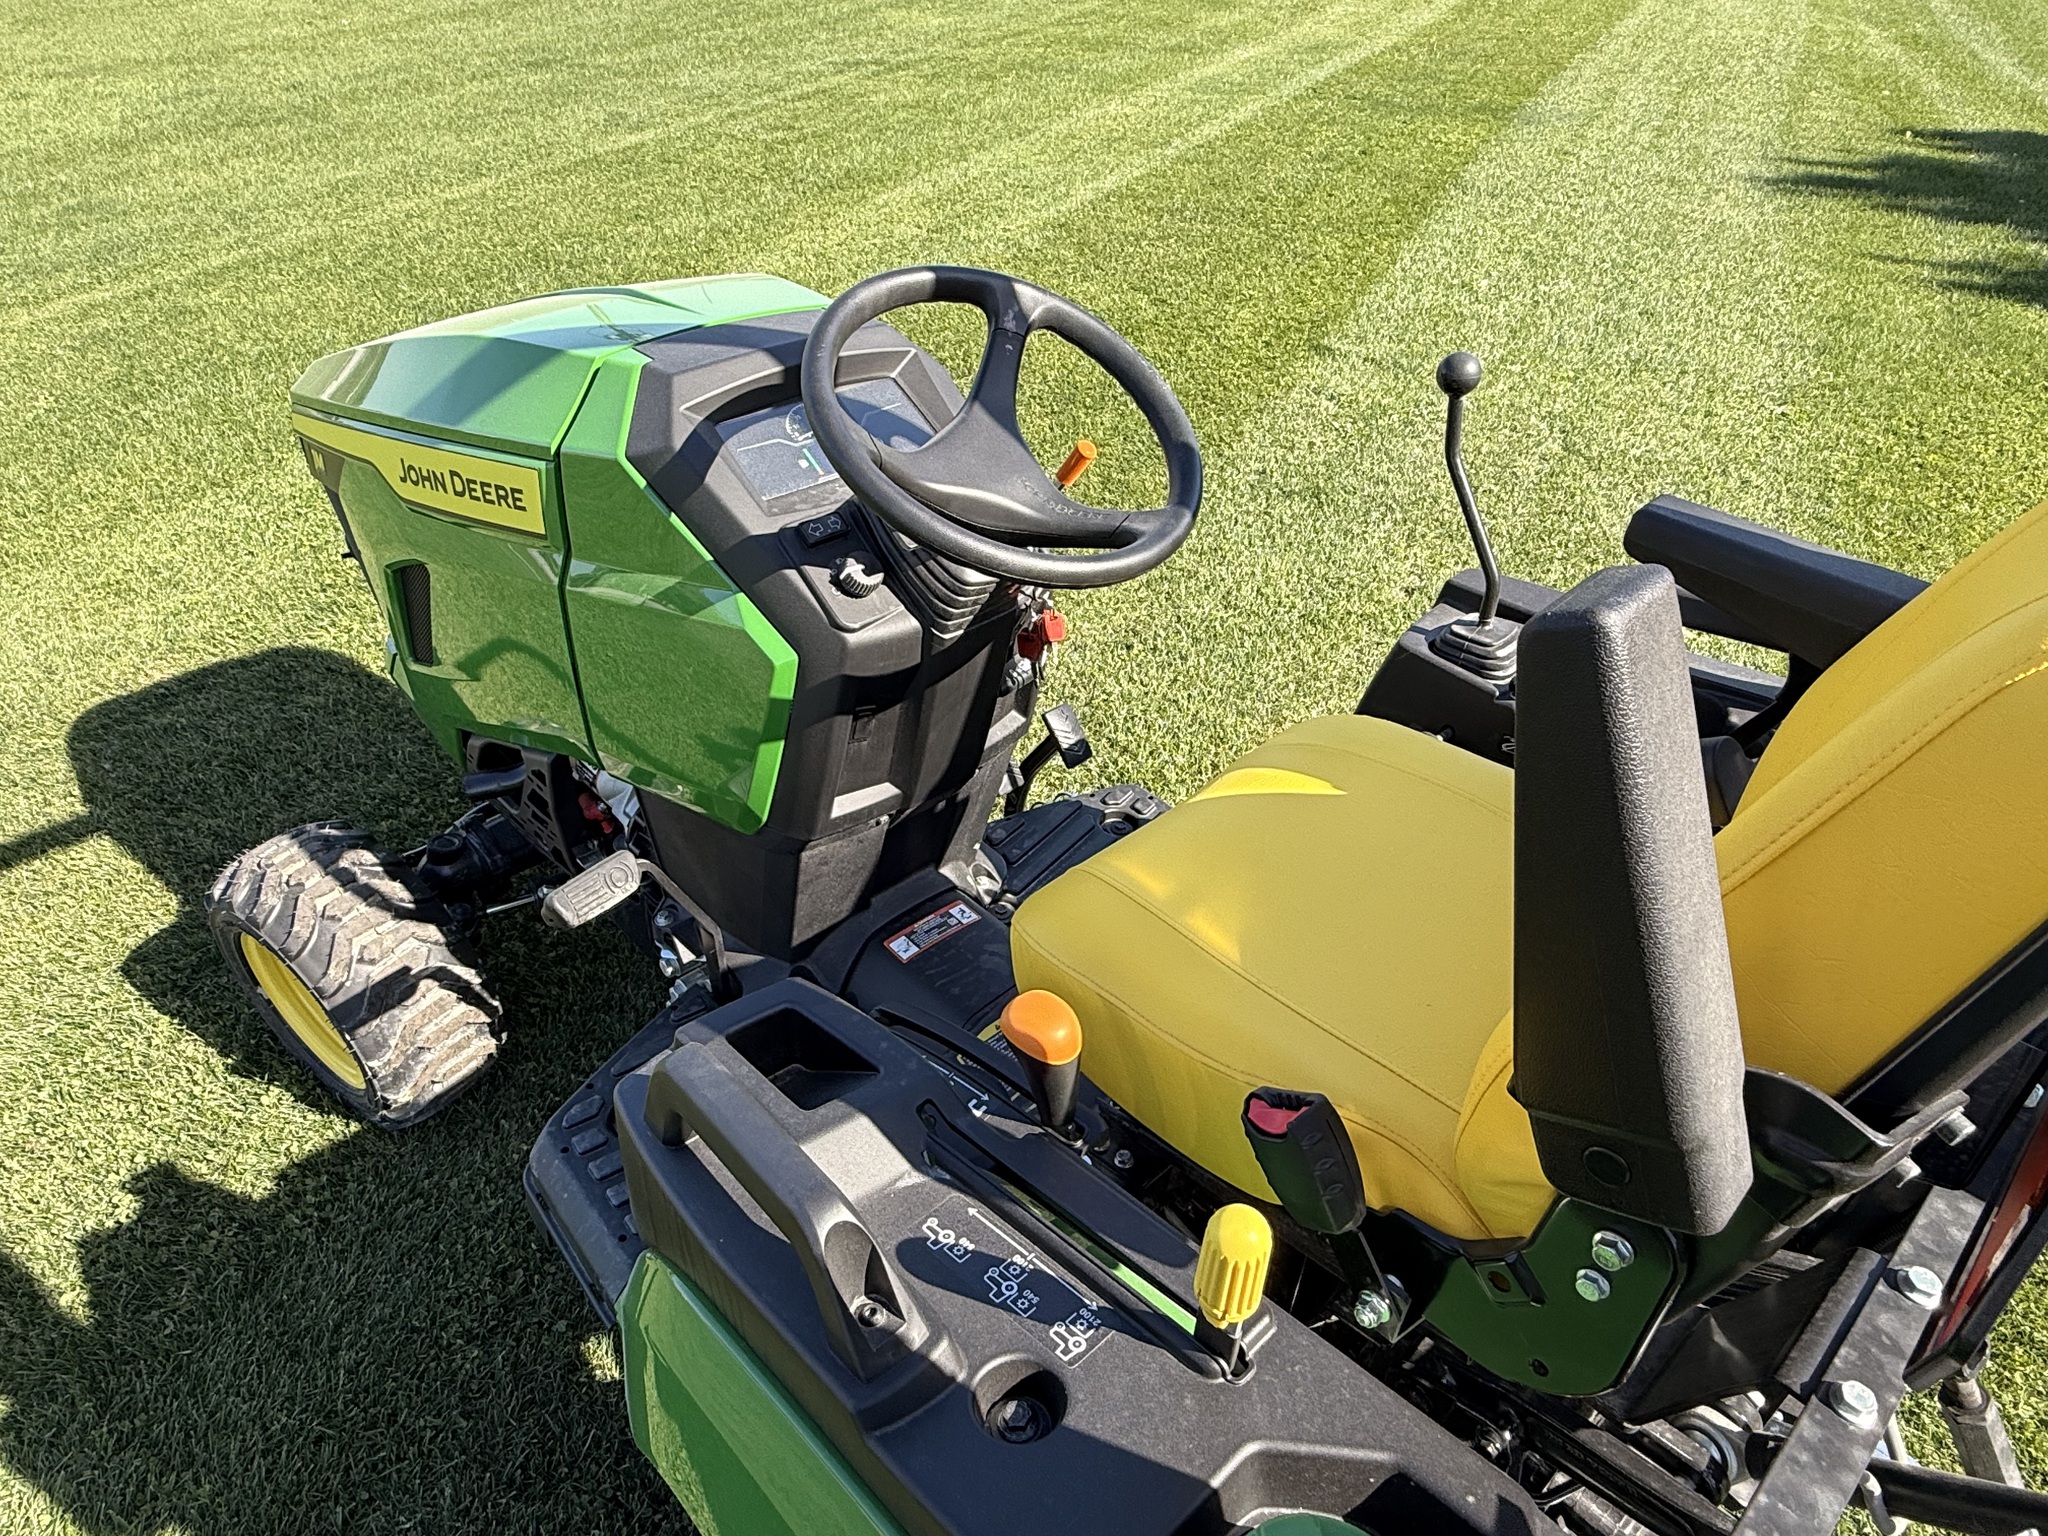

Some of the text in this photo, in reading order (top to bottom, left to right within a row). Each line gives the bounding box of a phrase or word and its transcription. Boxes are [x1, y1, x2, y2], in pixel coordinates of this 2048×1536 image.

[399, 457, 528, 512] JOHN DEERE
[1022, 1289, 1041, 1304] 540
[1079, 1307, 1102, 1327] 2100
